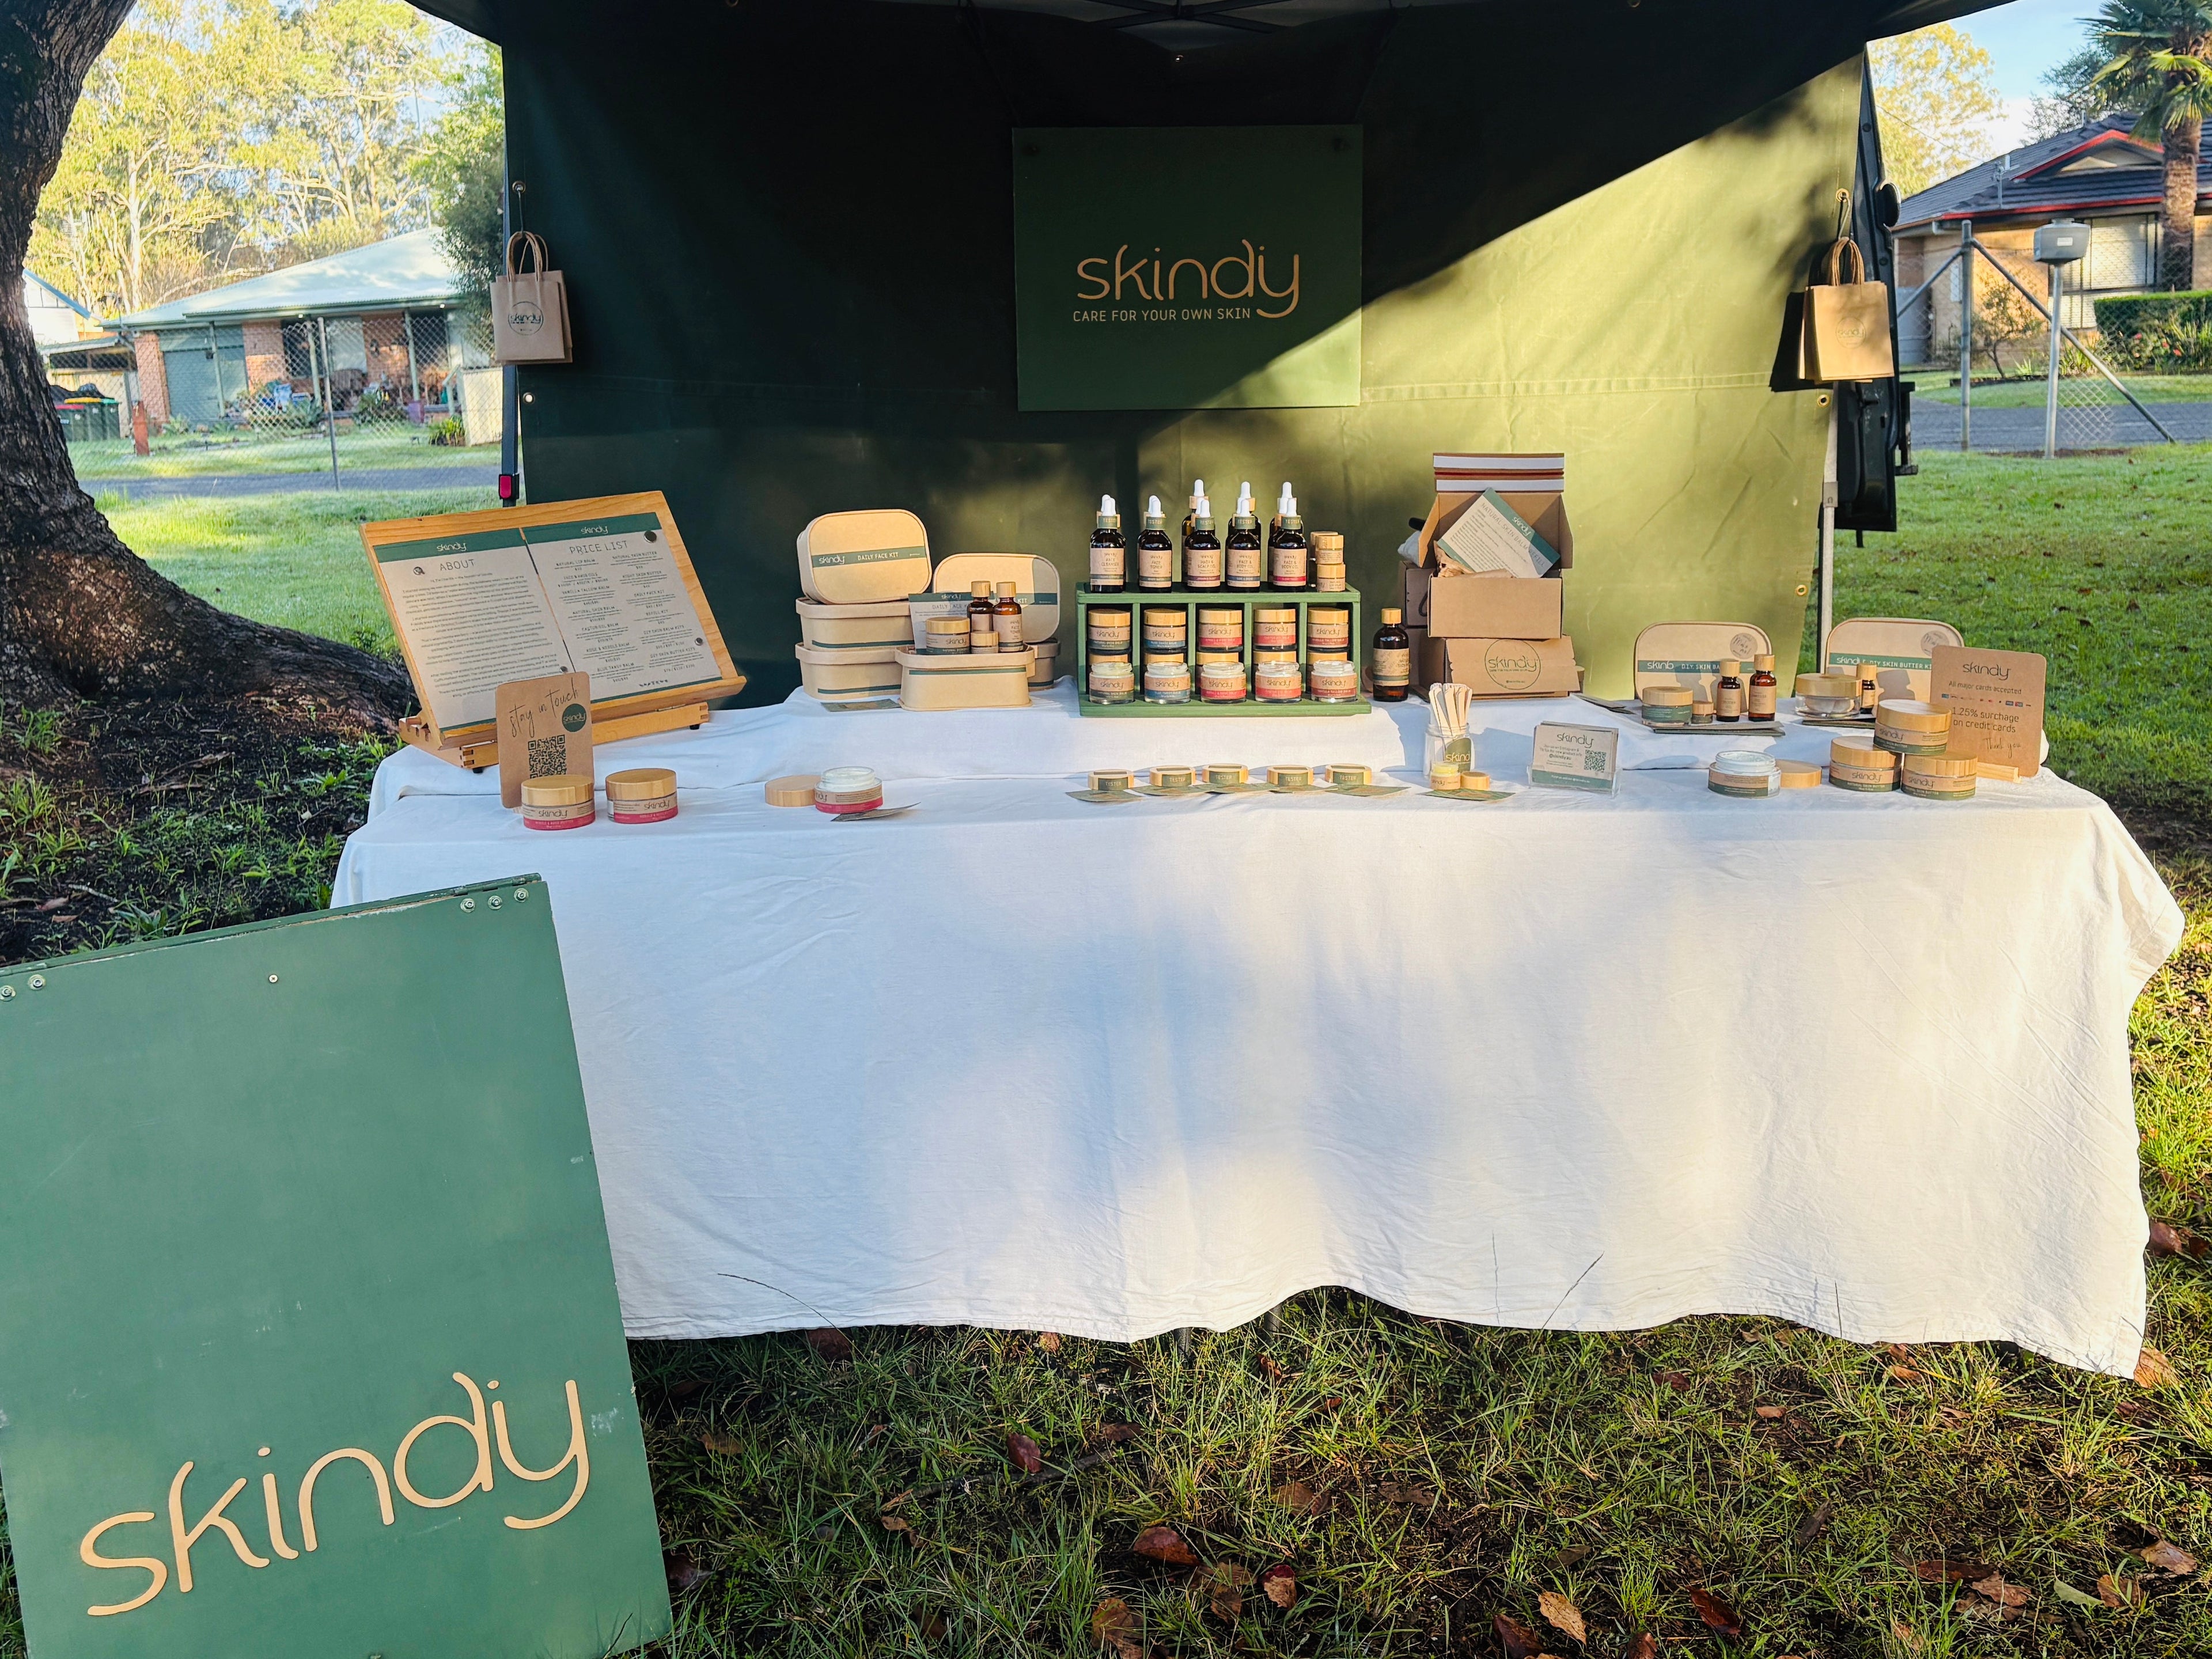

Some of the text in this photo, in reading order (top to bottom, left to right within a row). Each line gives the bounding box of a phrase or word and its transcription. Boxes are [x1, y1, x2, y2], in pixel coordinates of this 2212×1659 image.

[1077, 238, 1300, 319] skindy
[1073, 308, 1251, 322] CARE FOR YOUR OWN SKIN
[580, 525, 609, 535] skindy
[1481, 502, 1501, 525] NATURAL
[1502, 524, 1515, 538] SKIN
[1514, 536, 1529, 551] BALM
[1512, 516, 1532, 537] skindy
[436, 541, 467, 552] skindy
[569, 540, 628, 555] PRICE LIST
[440, 559, 475, 571] ABOUT
[819, 555, 845, 565] skindy
[1096, 630, 1120, 639] skindy
[1152, 630, 1176, 639] skindy
[1208, 627, 1232, 637] skindy
[1264, 625, 1289, 634] skindy
[1316, 627, 1340, 637] skindy
[1488, 655, 1537, 672] skindy
[1963, 662, 2010, 681] skindy
[1100, 680, 1124, 690] skindy
[1155, 680, 1180, 690] skindy
[1209, 680, 1233, 690] skindy
[1267, 679, 1291, 688] skindy
[1322, 679, 1347, 688] skindy
[1993, 686, 2022, 695] accepted
[539, 703, 547, 713] in
[1952, 707, 2020, 724] 1.25% surchage
[1965, 721, 1991, 730] credit
[1993, 723, 2016, 733] cards
[1556, 732, 1594, 749] skindy
[1983, 732, 2021, 759] Thank you
[1445, 751, 1471, 762] skind
[1851, 771, 1882, 783] skindy
[1908, 777, 1935, 789] skindy
[643, 800, 670, 810] skindy
[538, 809, 568, 819] skindy
[79, 1371, 590, 1616] skindy
